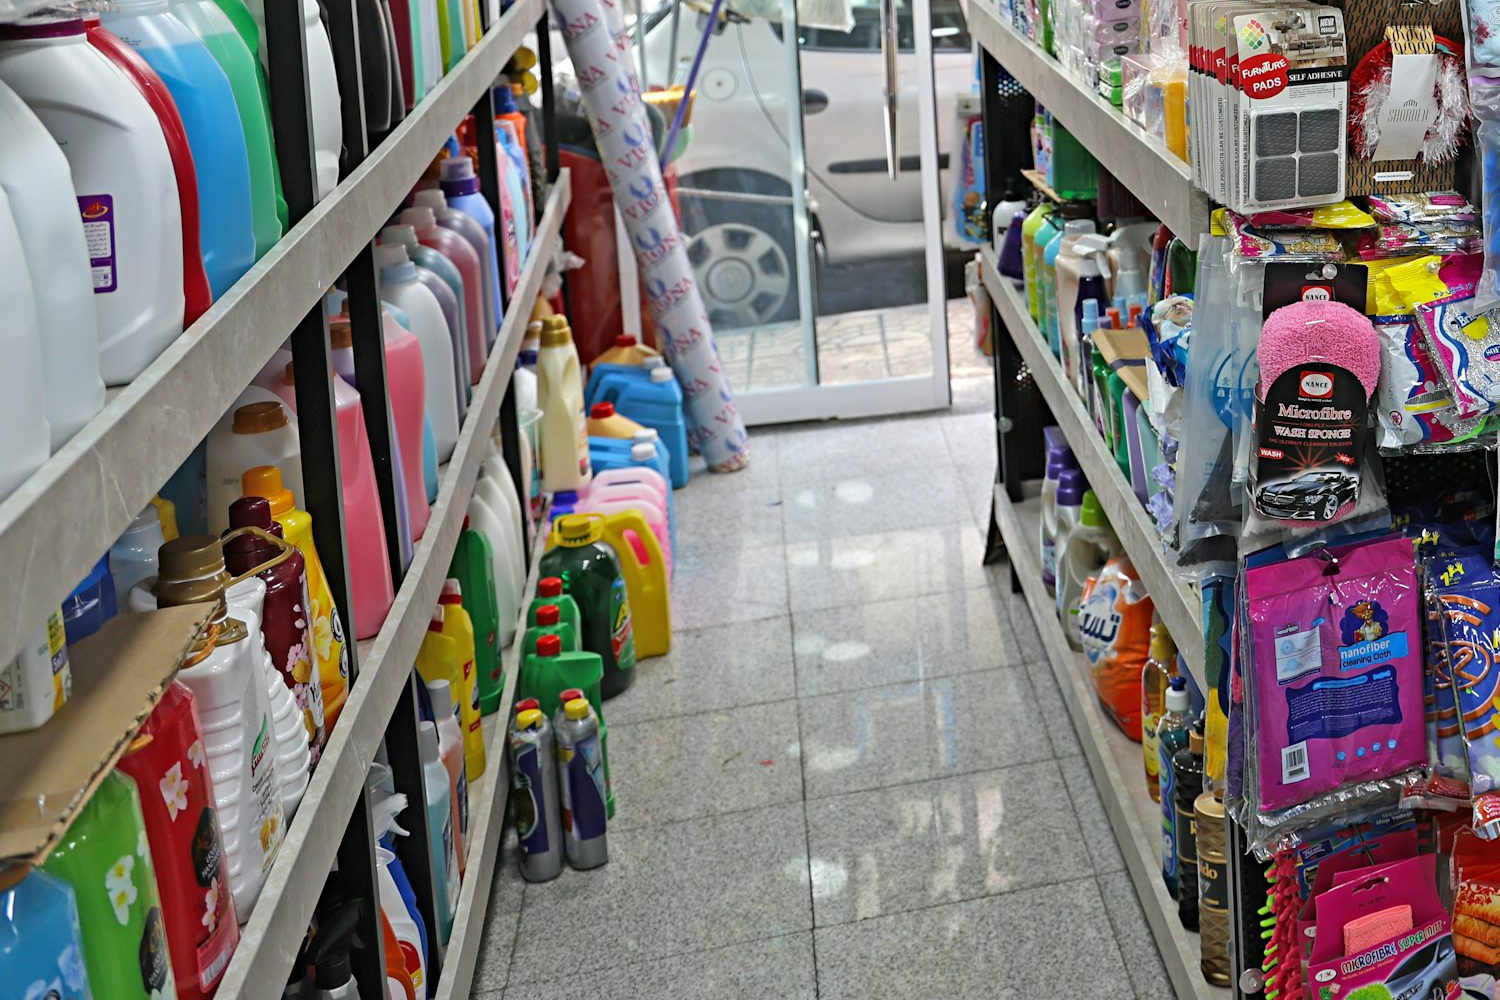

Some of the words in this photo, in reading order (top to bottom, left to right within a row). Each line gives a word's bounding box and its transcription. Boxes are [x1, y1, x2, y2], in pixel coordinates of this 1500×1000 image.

[1241, 58, 1287, 79] FURNITURE
[1289, 73, 1307, 82] SELF
[1307, 71, 1343, 81] ADHESIVE
[1253, 77, 1281, 92] PADS
[1278, 402, 1352, 421] Microfibre
[1274, 425, 1307, 438] WASH
[1308, 428, 1351, 439] SPONGE
[1260, 449, 1282, 458] WASH
[1340, 639, 1391, 659] nanofiber
[1342, 655, 1372, 667] cleaning
[1373, 650, 1392, 660] Cloth
[1341, 942, 1398, 974] MICROFIBRE
[1398, 931, 1425, 953] SUPER
